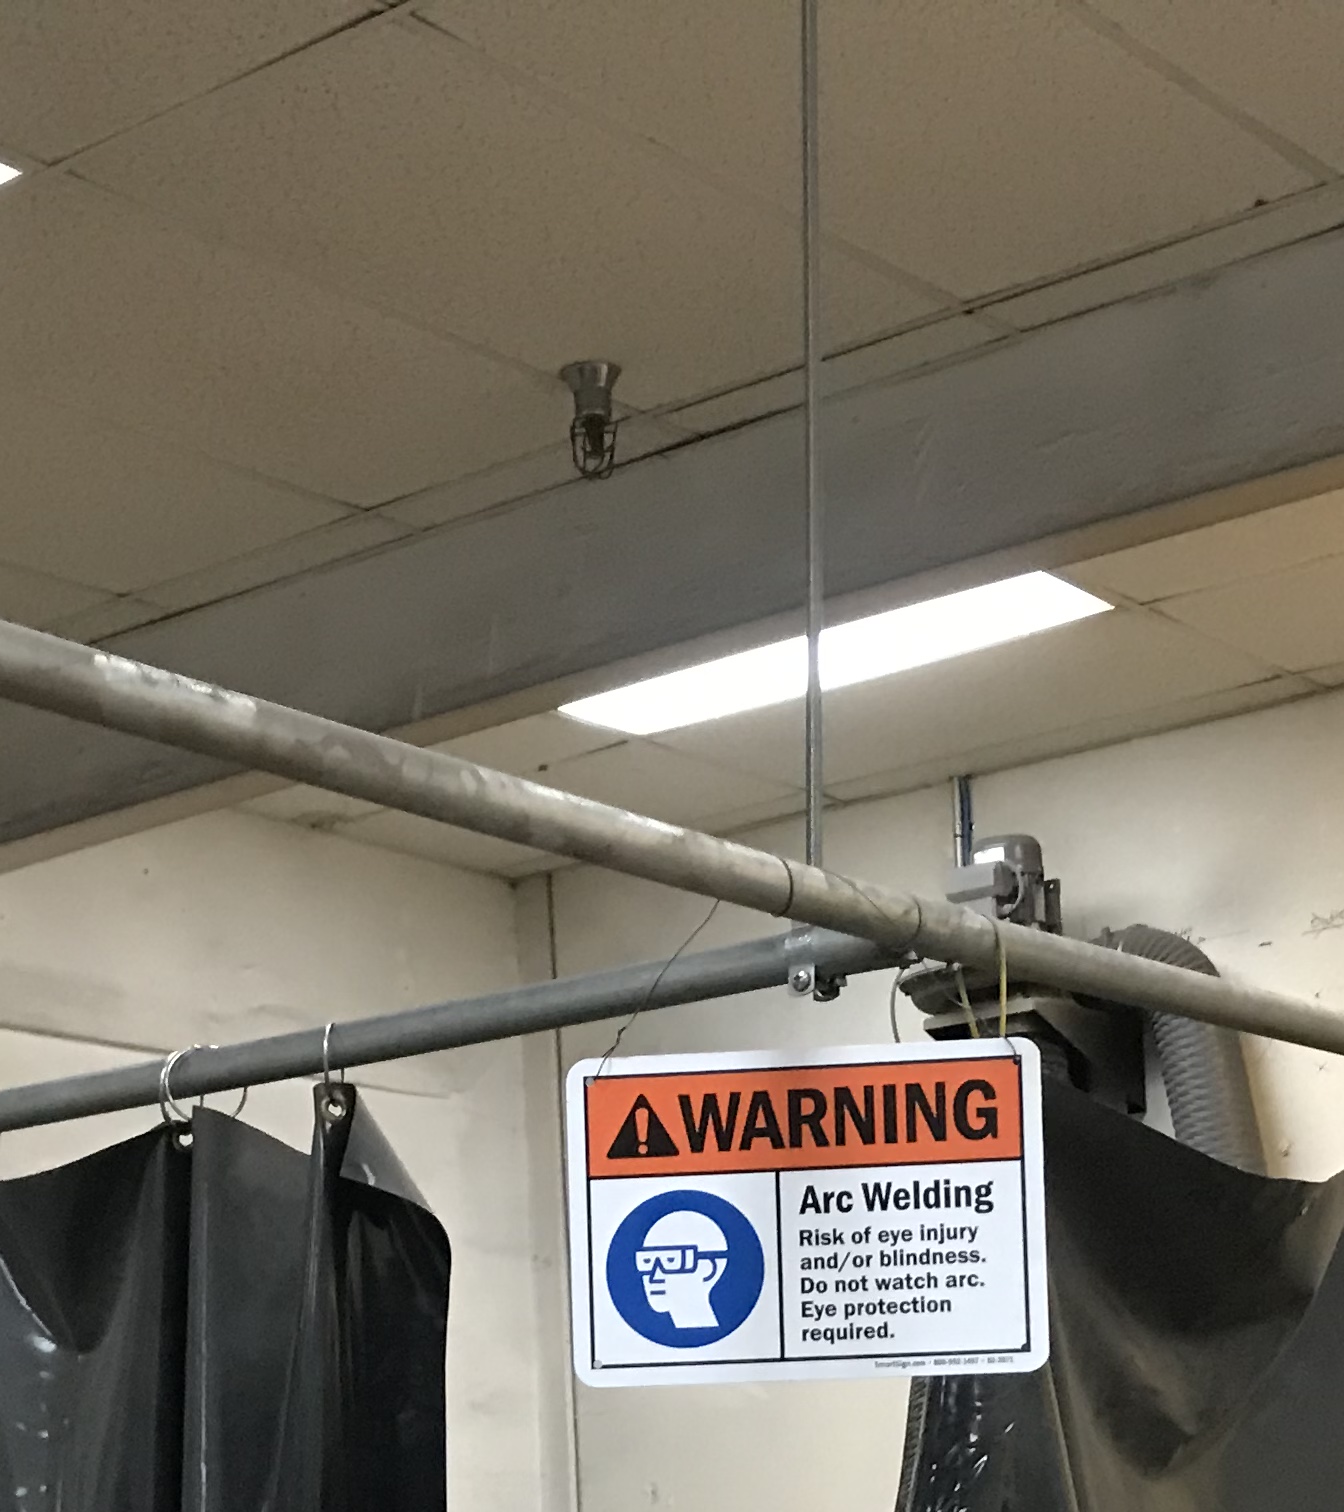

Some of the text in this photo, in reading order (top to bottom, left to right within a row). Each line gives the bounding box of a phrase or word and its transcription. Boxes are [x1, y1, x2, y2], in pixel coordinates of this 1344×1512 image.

[677, 1079, 999, 1154] WARNING
[798, 1178, 994, 1215] Arc Welding
[799, 1223, 978, 1247] Risk of eye injury
[800, 1248, 986, 1273] and/or blindness.
[800, 1271, 985, 1295] Do not watch arc.
[801, 1295, 952, 1322] Eye protection
[802, 1321, 895, 1345] required.
